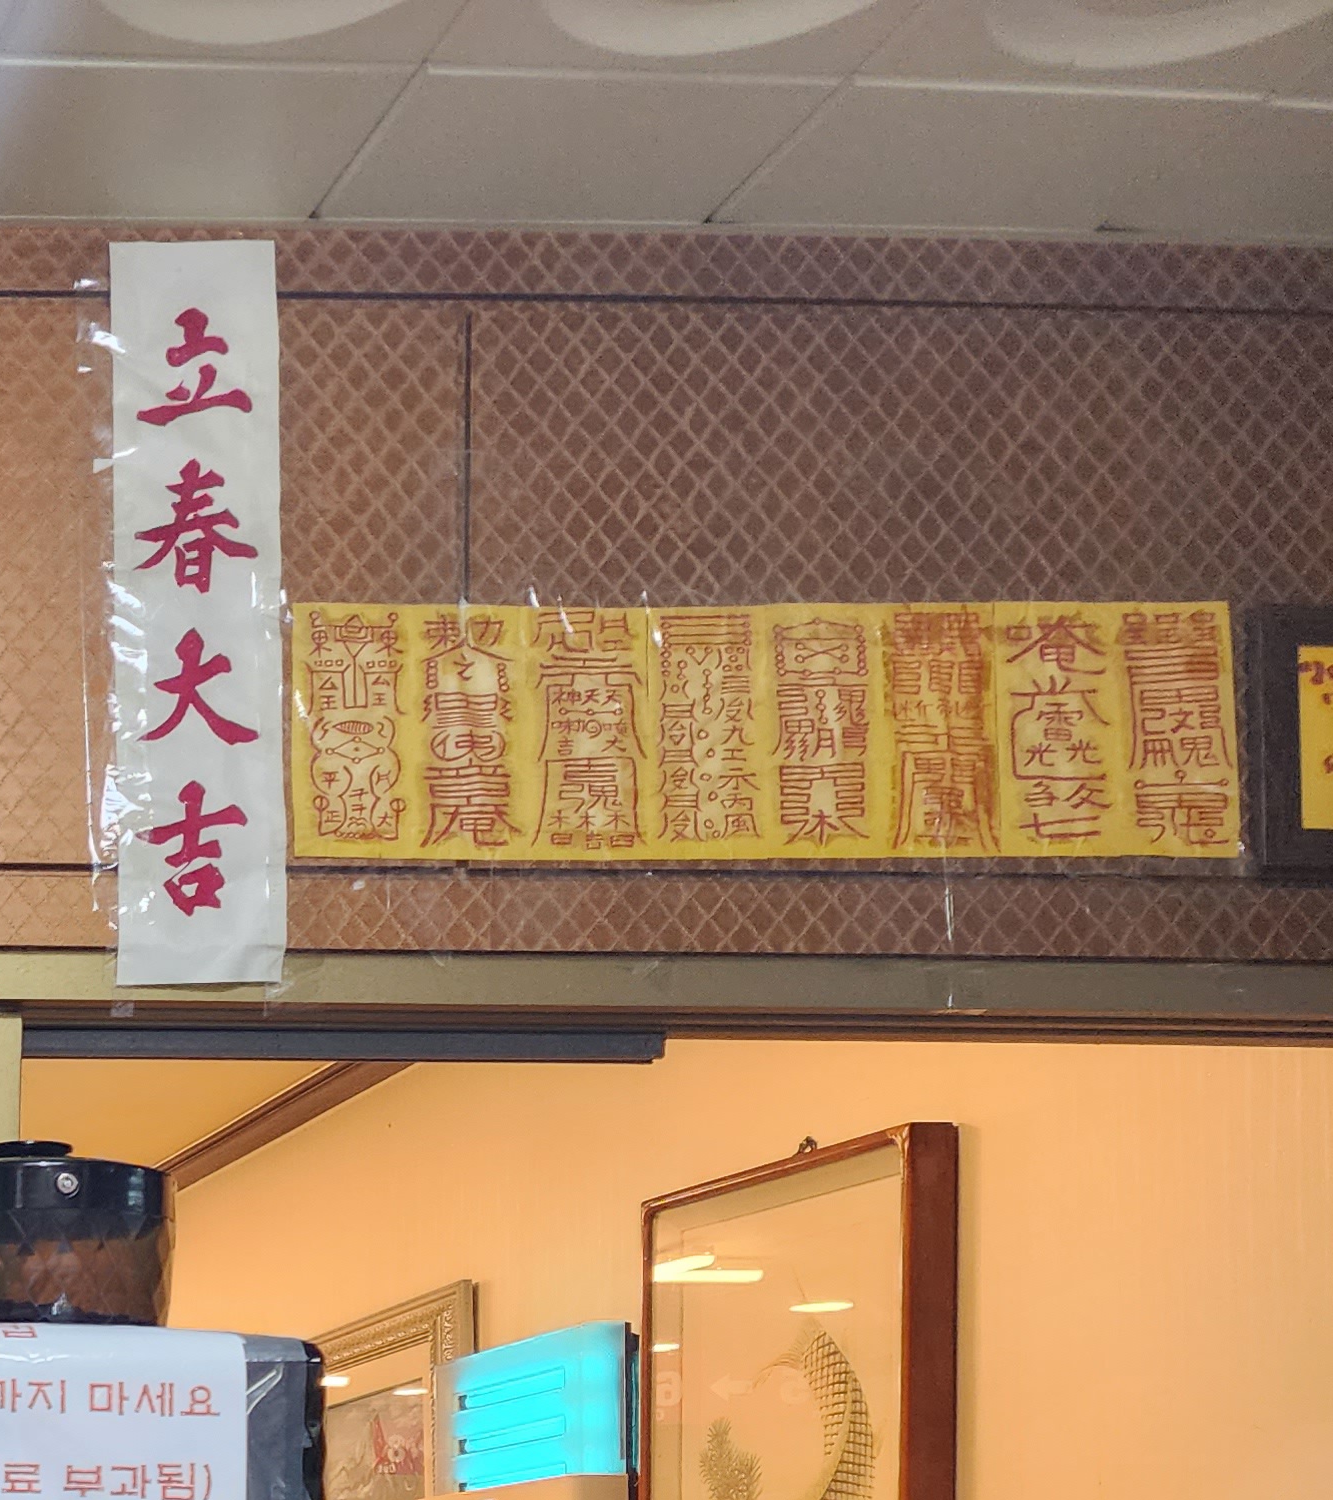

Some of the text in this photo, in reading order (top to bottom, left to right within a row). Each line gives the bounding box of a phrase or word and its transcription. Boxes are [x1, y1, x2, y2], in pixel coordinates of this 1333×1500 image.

[135, 307, 259, 917] 立春大吉
[90, 1381, 220, 1418] 마세요
